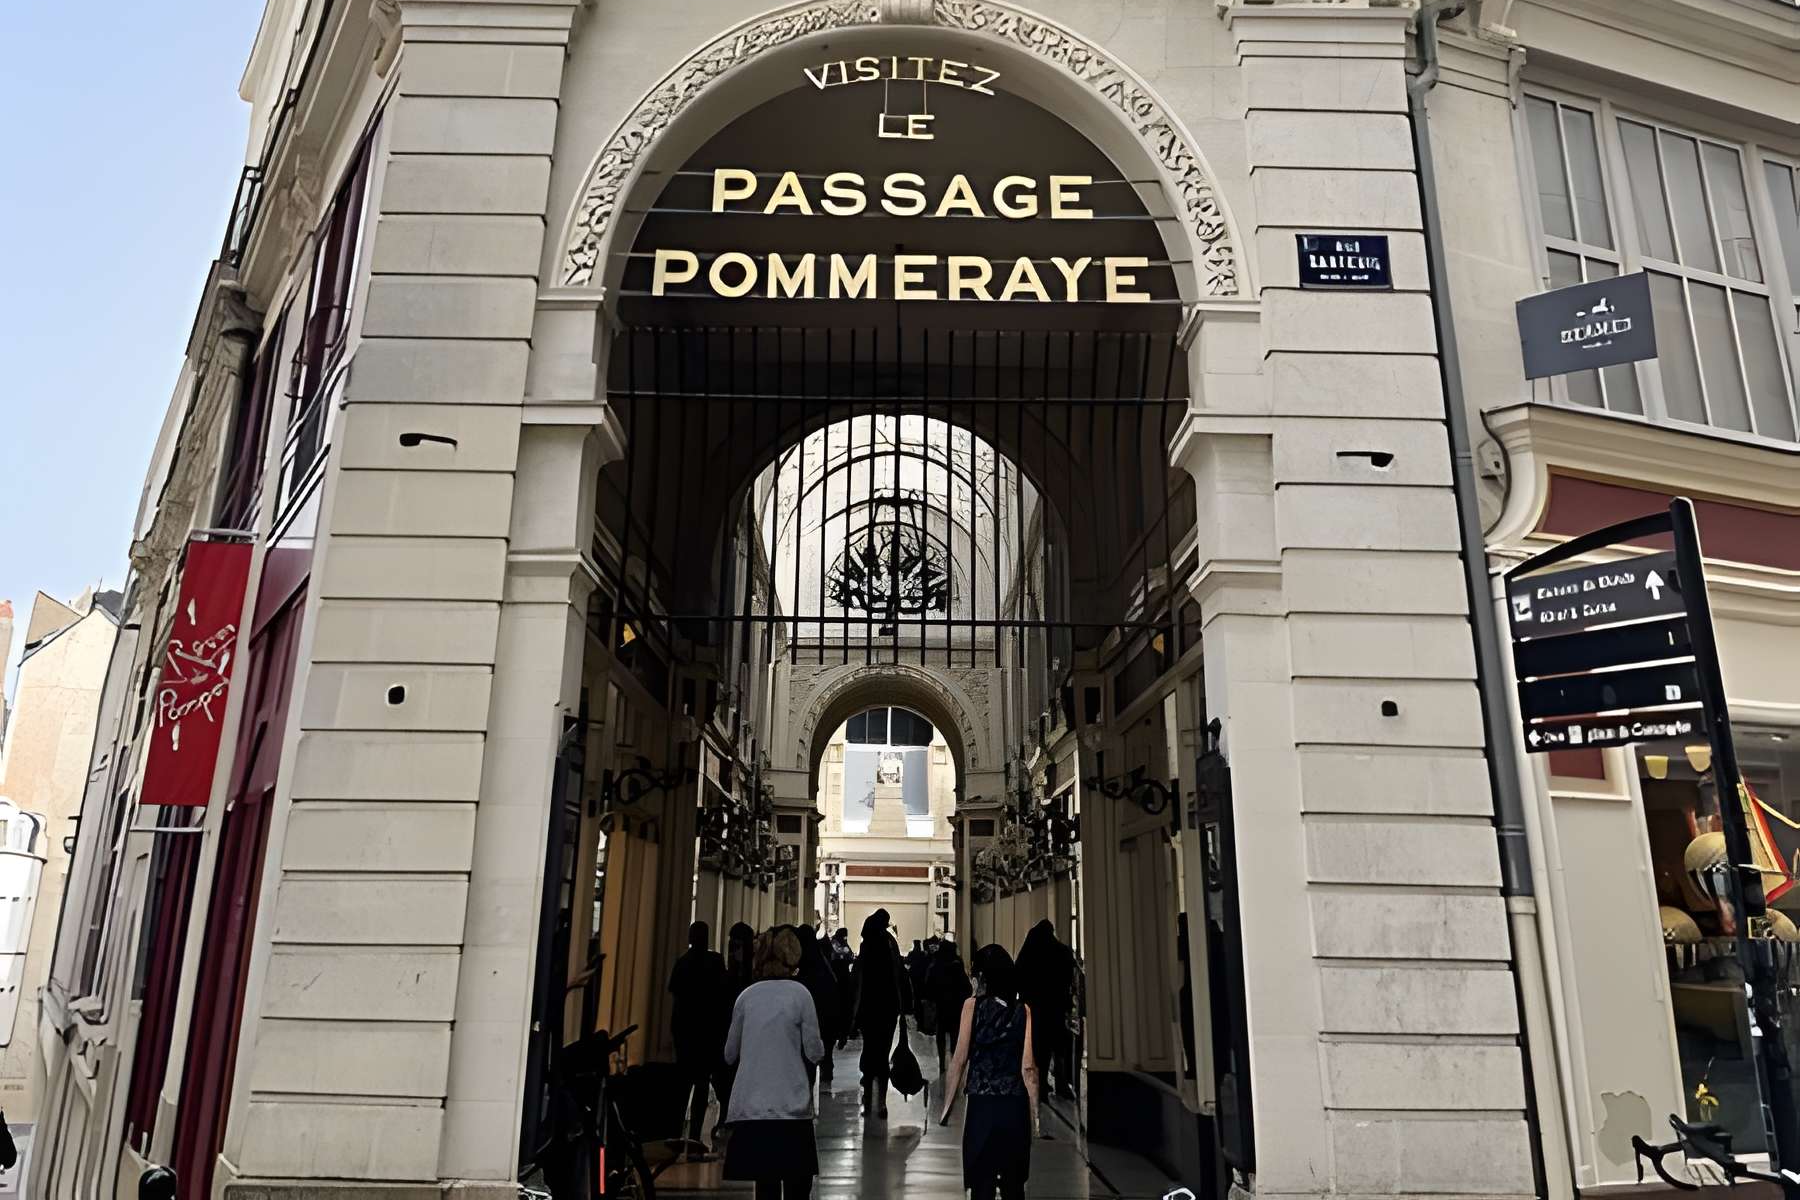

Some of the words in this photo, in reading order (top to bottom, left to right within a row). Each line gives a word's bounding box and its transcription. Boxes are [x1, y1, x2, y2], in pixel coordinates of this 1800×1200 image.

[803, 56, 1002, 96] VISITEZ
[878, 113, 935, 141] LE
[711, 169, 1094, 220] PASSAGE
[652, 249, 1152, 304] POMMERAYE
